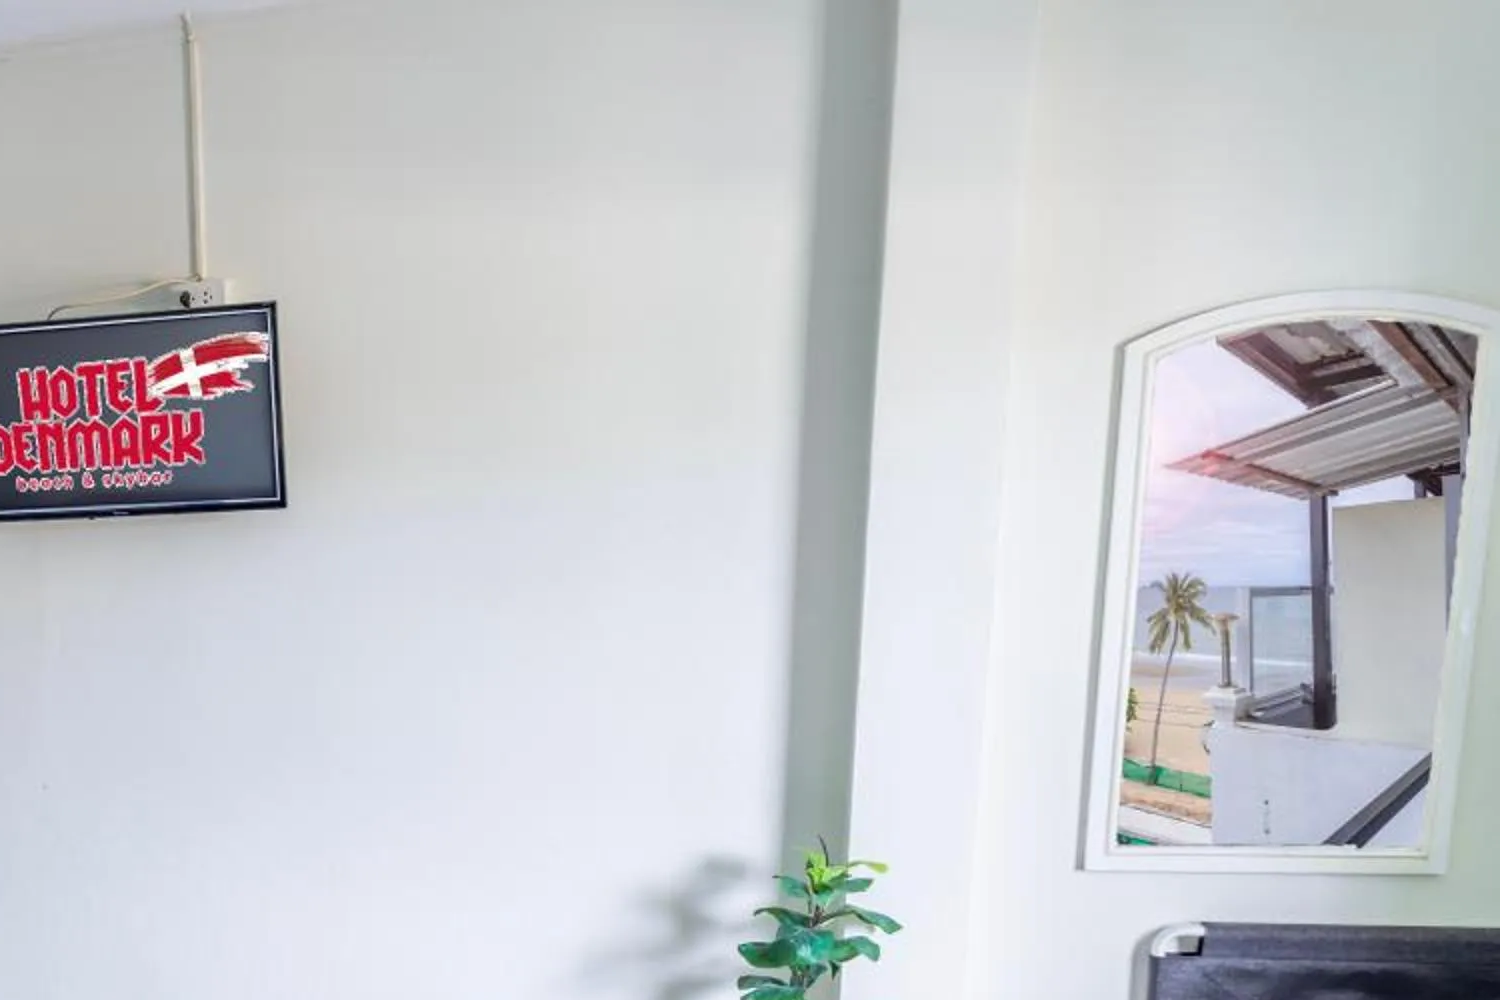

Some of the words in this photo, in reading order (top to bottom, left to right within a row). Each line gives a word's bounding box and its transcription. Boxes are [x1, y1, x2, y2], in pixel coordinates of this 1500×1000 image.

[17, 357, 165, 421] HOTEL
[16, 475, 74, 493] beach
[82, 472, 95, 489] &
